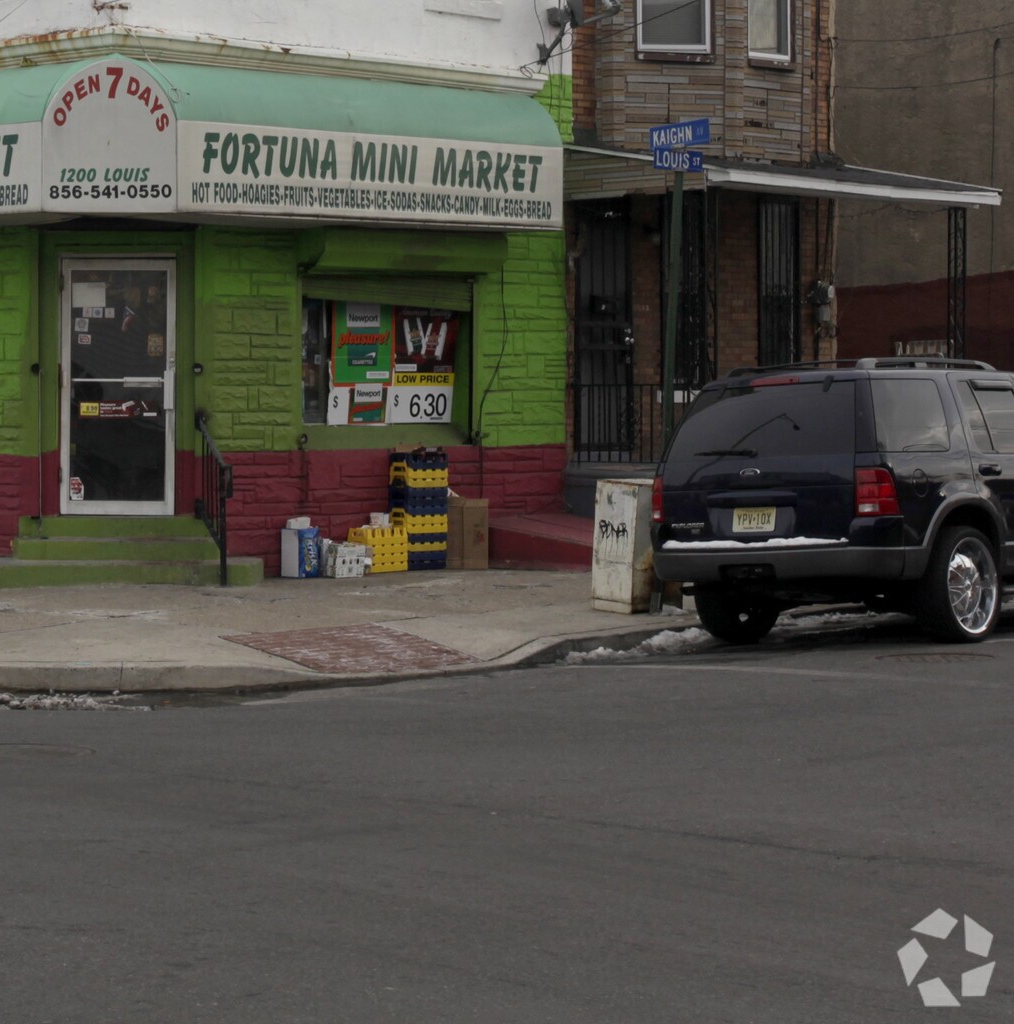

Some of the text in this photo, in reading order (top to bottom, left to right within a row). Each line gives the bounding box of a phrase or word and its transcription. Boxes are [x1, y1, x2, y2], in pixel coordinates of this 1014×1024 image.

[53, 67, 169, 132] OPEN 7 DAYS
[652, 125, 704, 147] KAIGHN AV
[202, 132, 544, 194] FORTUNA MINI MARKET
[655, 150, 701, 169] LOUIS ST
[59, 167, 150, 183] 1200 LOUIS
[49, 184, 173, 199] 856-541-0550
[191, 182, 210, 203] HOT
[348, 314, 379, 323] Newport
[337, 329, 390, 349] pleasure!
[396, 375, 417, 384] LOW
[420, 374, 450, 384] PRICE
[356, 389, 381, 397] Newport
[409, 393, 447, 420] 6.30
